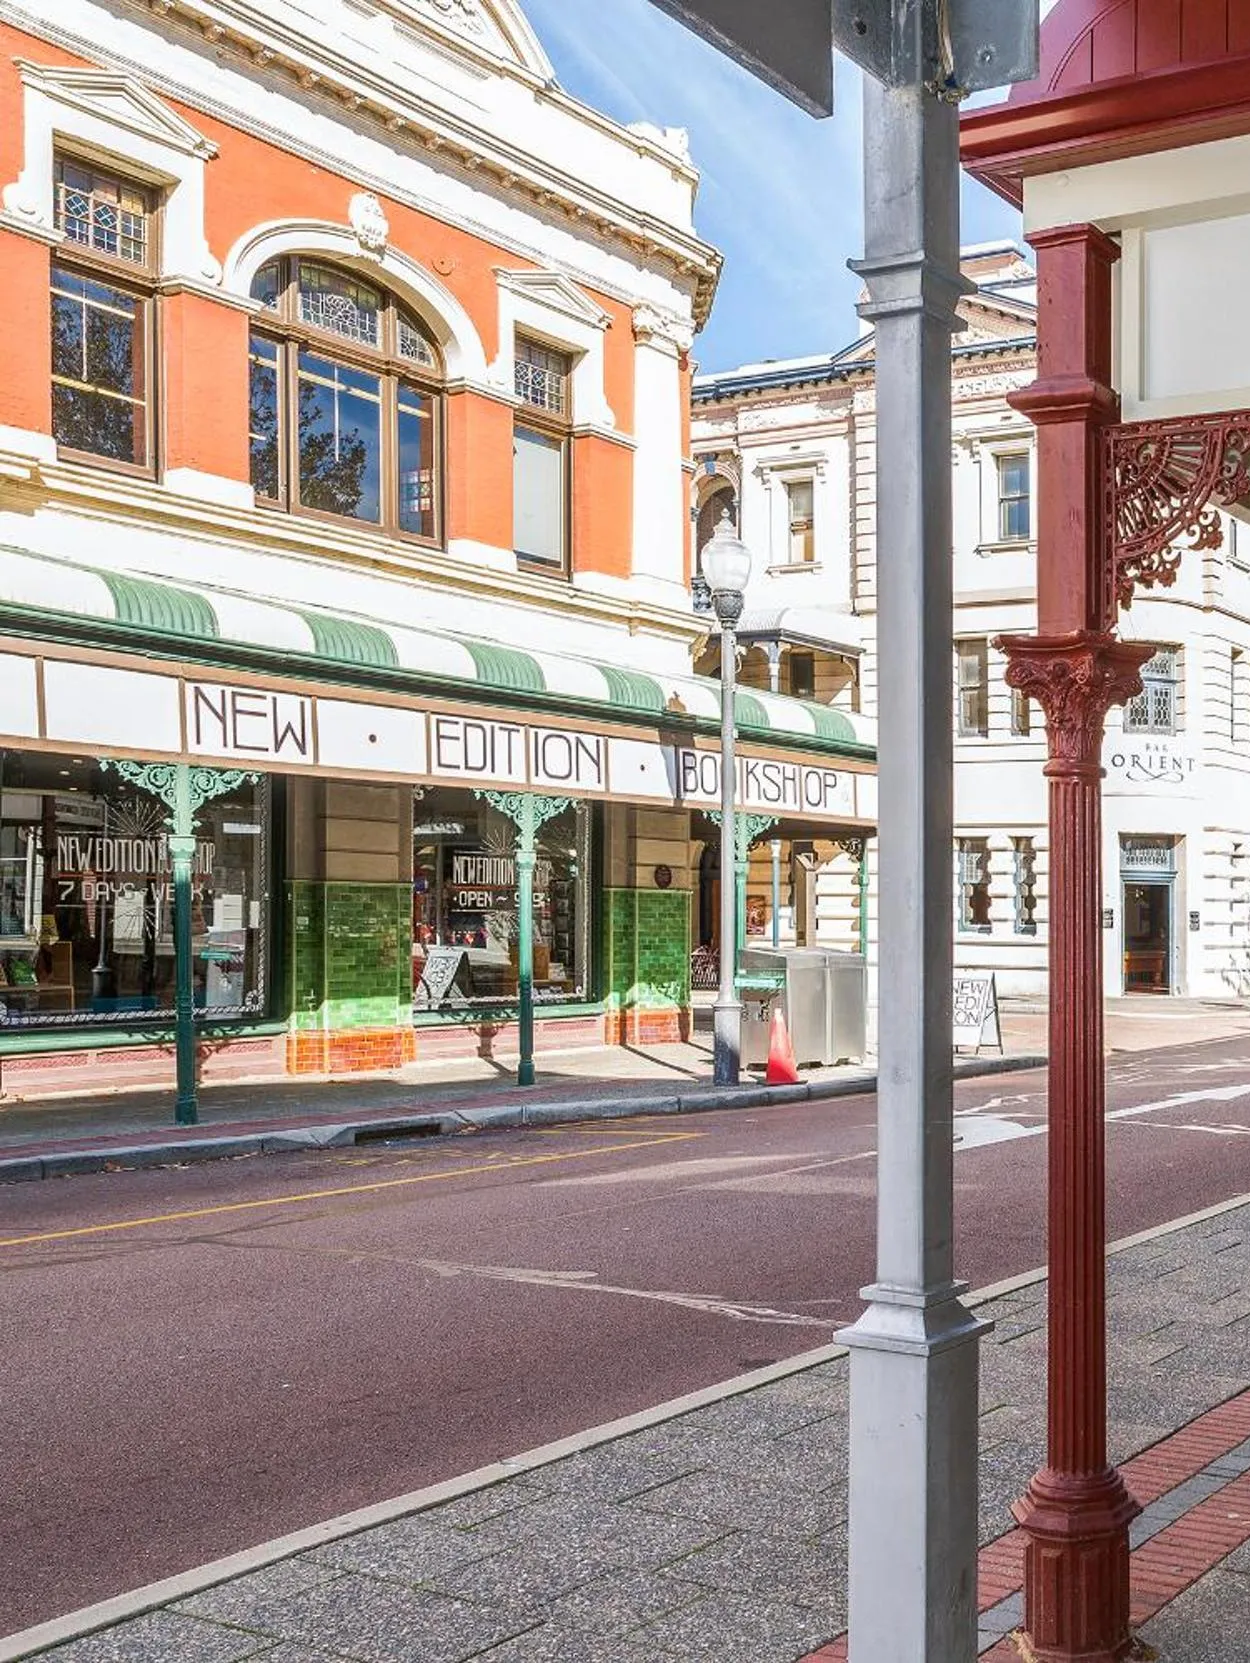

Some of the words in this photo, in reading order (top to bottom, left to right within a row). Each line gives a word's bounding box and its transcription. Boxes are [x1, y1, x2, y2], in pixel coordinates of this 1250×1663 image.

[194, 686, 307, 755] NEW
[436, 718, 601, 784] EDITION
[682, 751, 837, 808] BOKSHOP
[1111, 754, 1195, 779] ORIENT
[57, 836, 92, 871] NEW
[95, 837, 157, 874] EDITION
[58, 881, 75, 900] 7
[151, 883, 204, 901] WEK
[459, 891, 493, 907] OPEN
